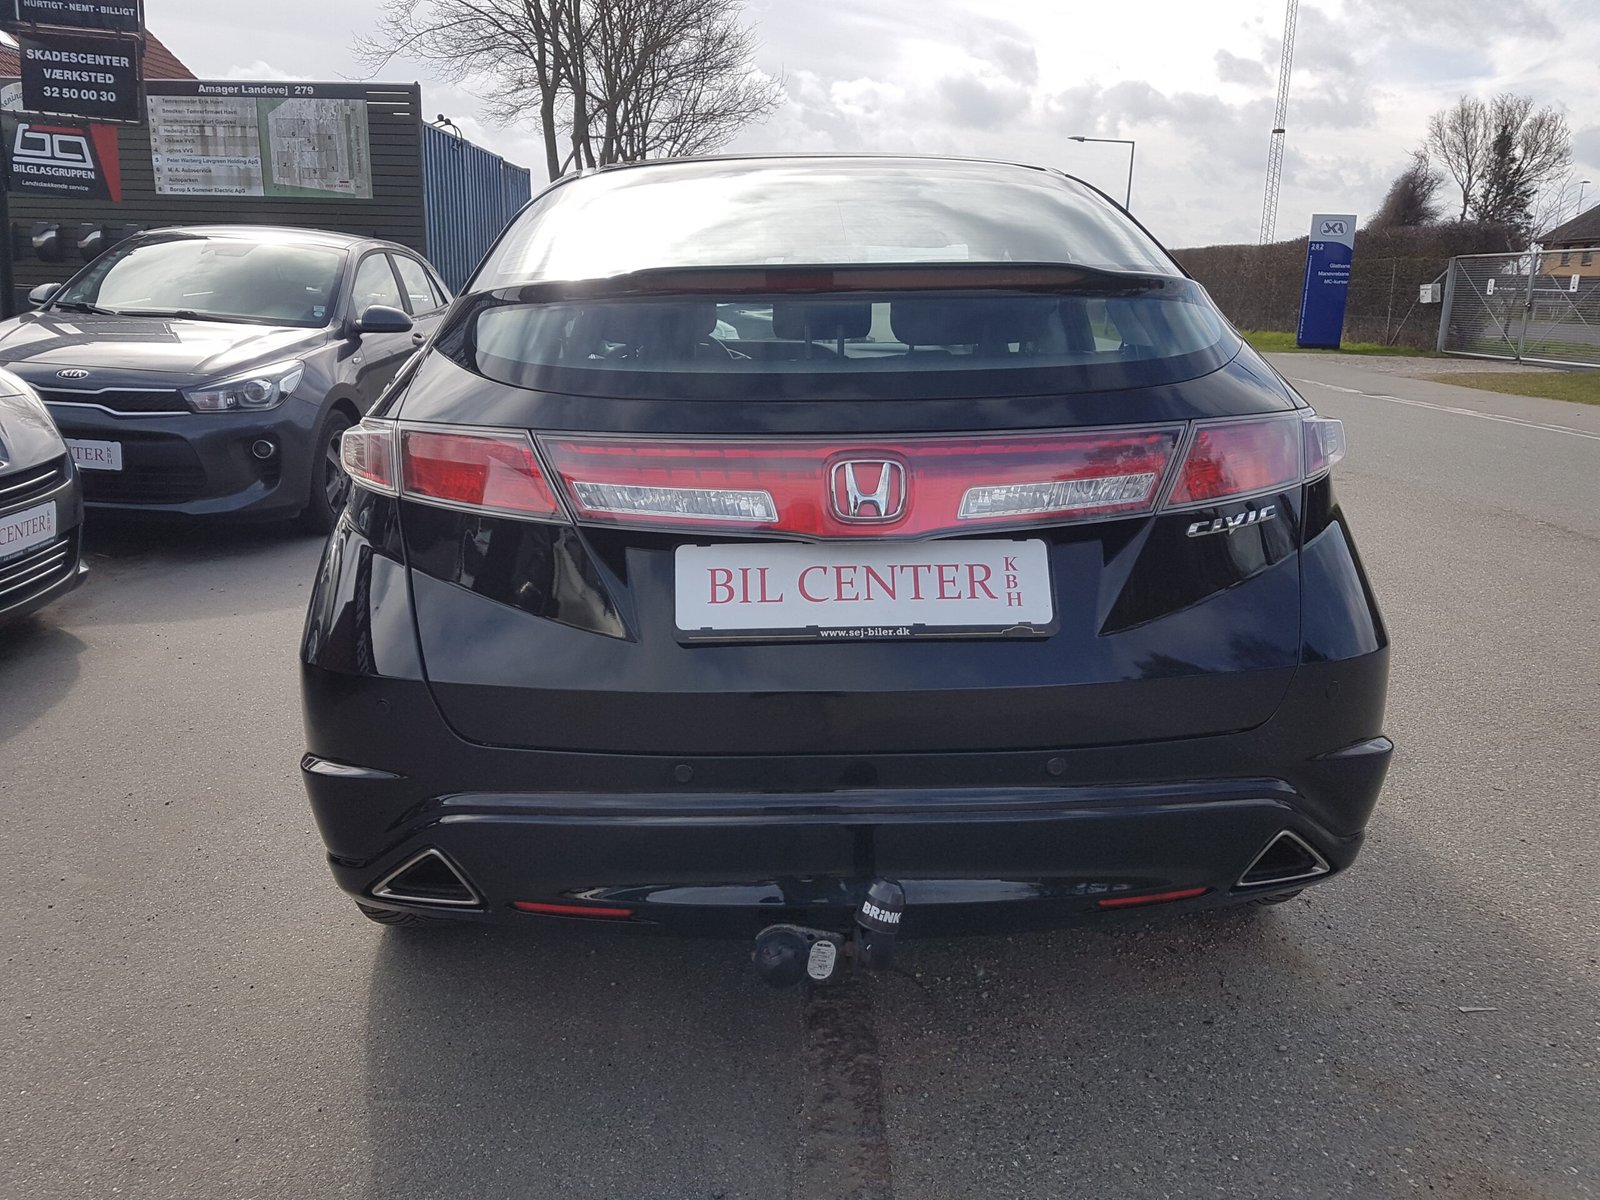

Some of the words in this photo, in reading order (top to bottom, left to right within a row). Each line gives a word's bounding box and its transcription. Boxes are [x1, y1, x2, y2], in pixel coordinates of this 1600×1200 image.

[26, 49, 129, 67] SKADESCENTER
[43, 68, 114, 84] VÆRKSTED
[43, 86, 59, 97] 32
[62, 88, 78, 98] 50
[80, 90, 97, 100] 00
[100, 92, 116, 102] 30
[198, 84, 238, 95] Amager
[242, 85, 289, 96] Landevej
[294, 86, 314, 94] 279
[12, 164, 95, 179] BILGLASGRUPPEN
[22, 180, 68, 190] Landsdækkende
[1187, 505, 1276, 538] CIVIC
[706, 566, 784, 605] BIL
[798, 563, 999, 602] CENTER
[820, 626, 910, 638] www.sej-biler.dk
